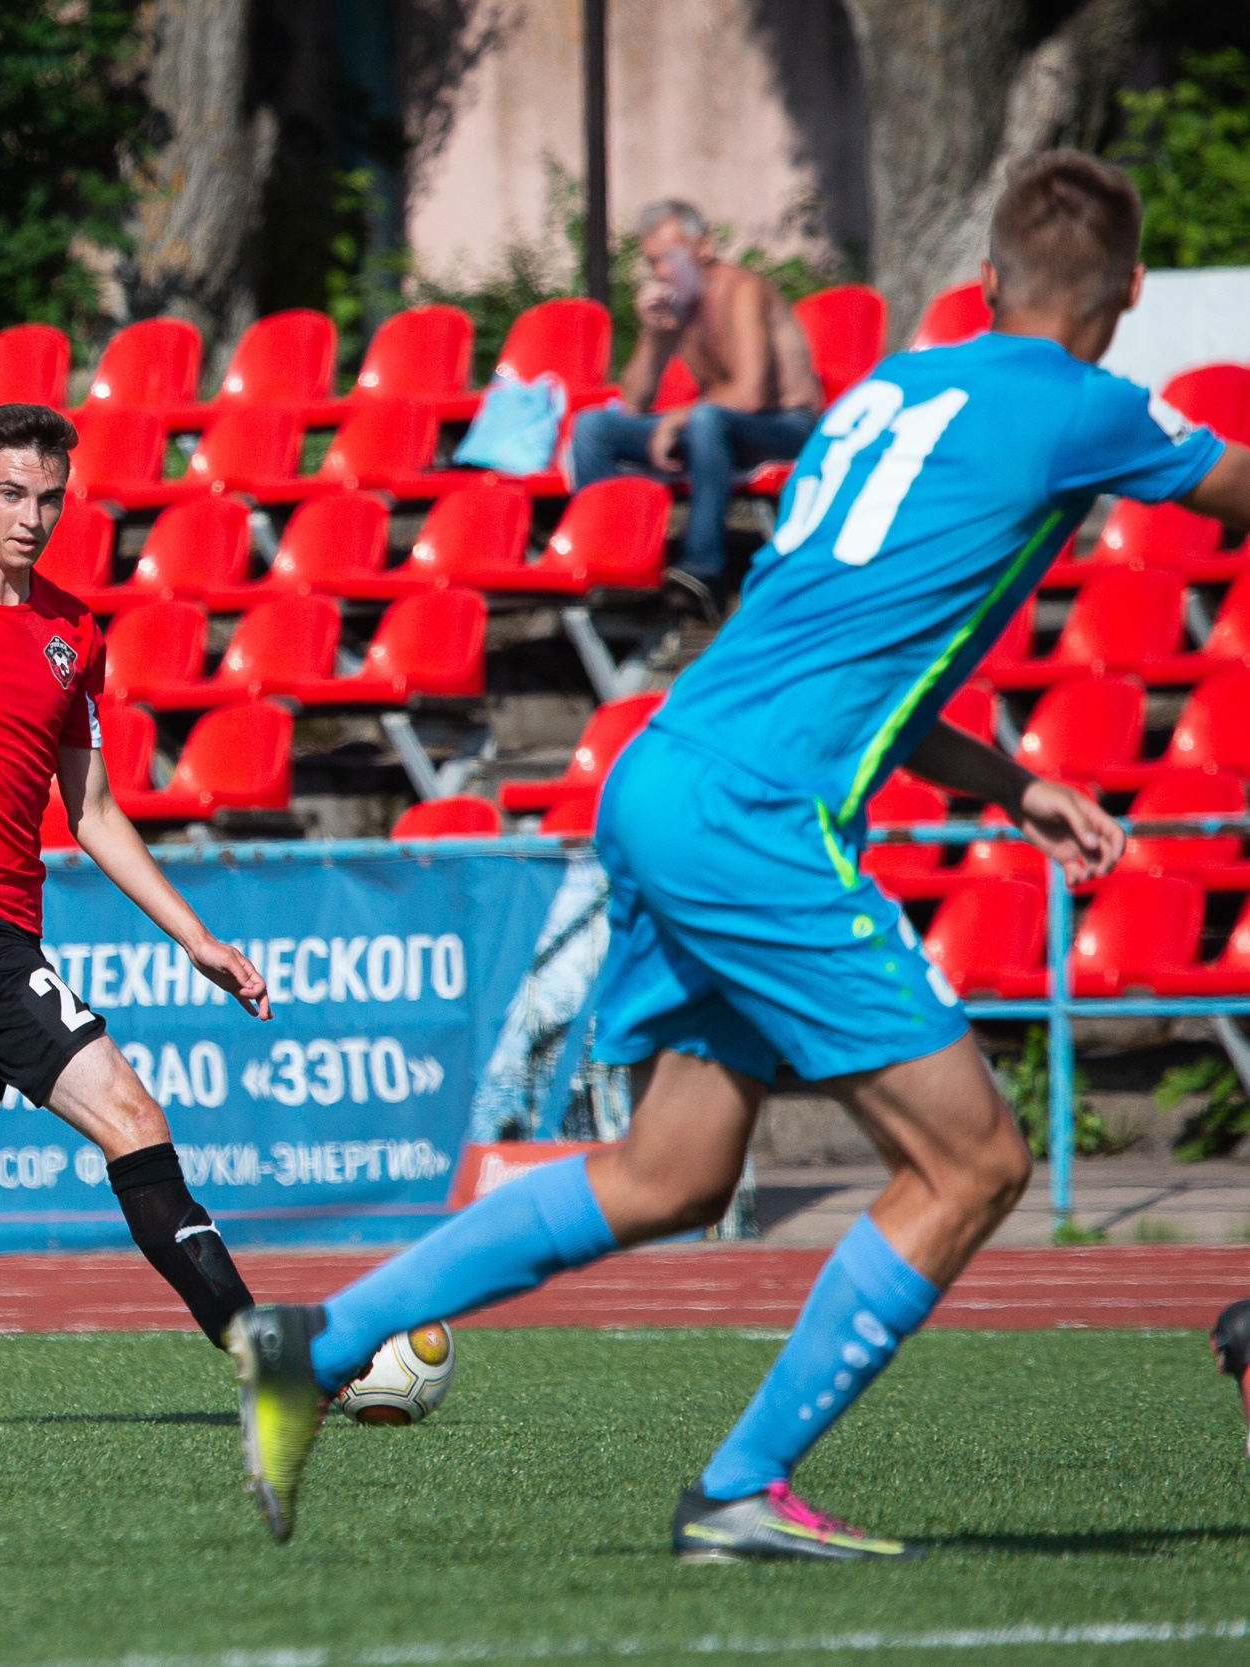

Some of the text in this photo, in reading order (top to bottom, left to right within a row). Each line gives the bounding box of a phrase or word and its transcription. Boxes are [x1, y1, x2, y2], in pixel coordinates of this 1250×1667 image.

[773, 380, 969, 566] 31
[29, 967, 96, 1033] 2
[120, 1039, 228, 1108] ЗАО
[241, 1034, 445, 1106] «ЗЭТО»
[74, 1144, 111, 1188] Ф
[175, 1137, 451, 1187] УКИ-ЭНЕРГИЯ»
